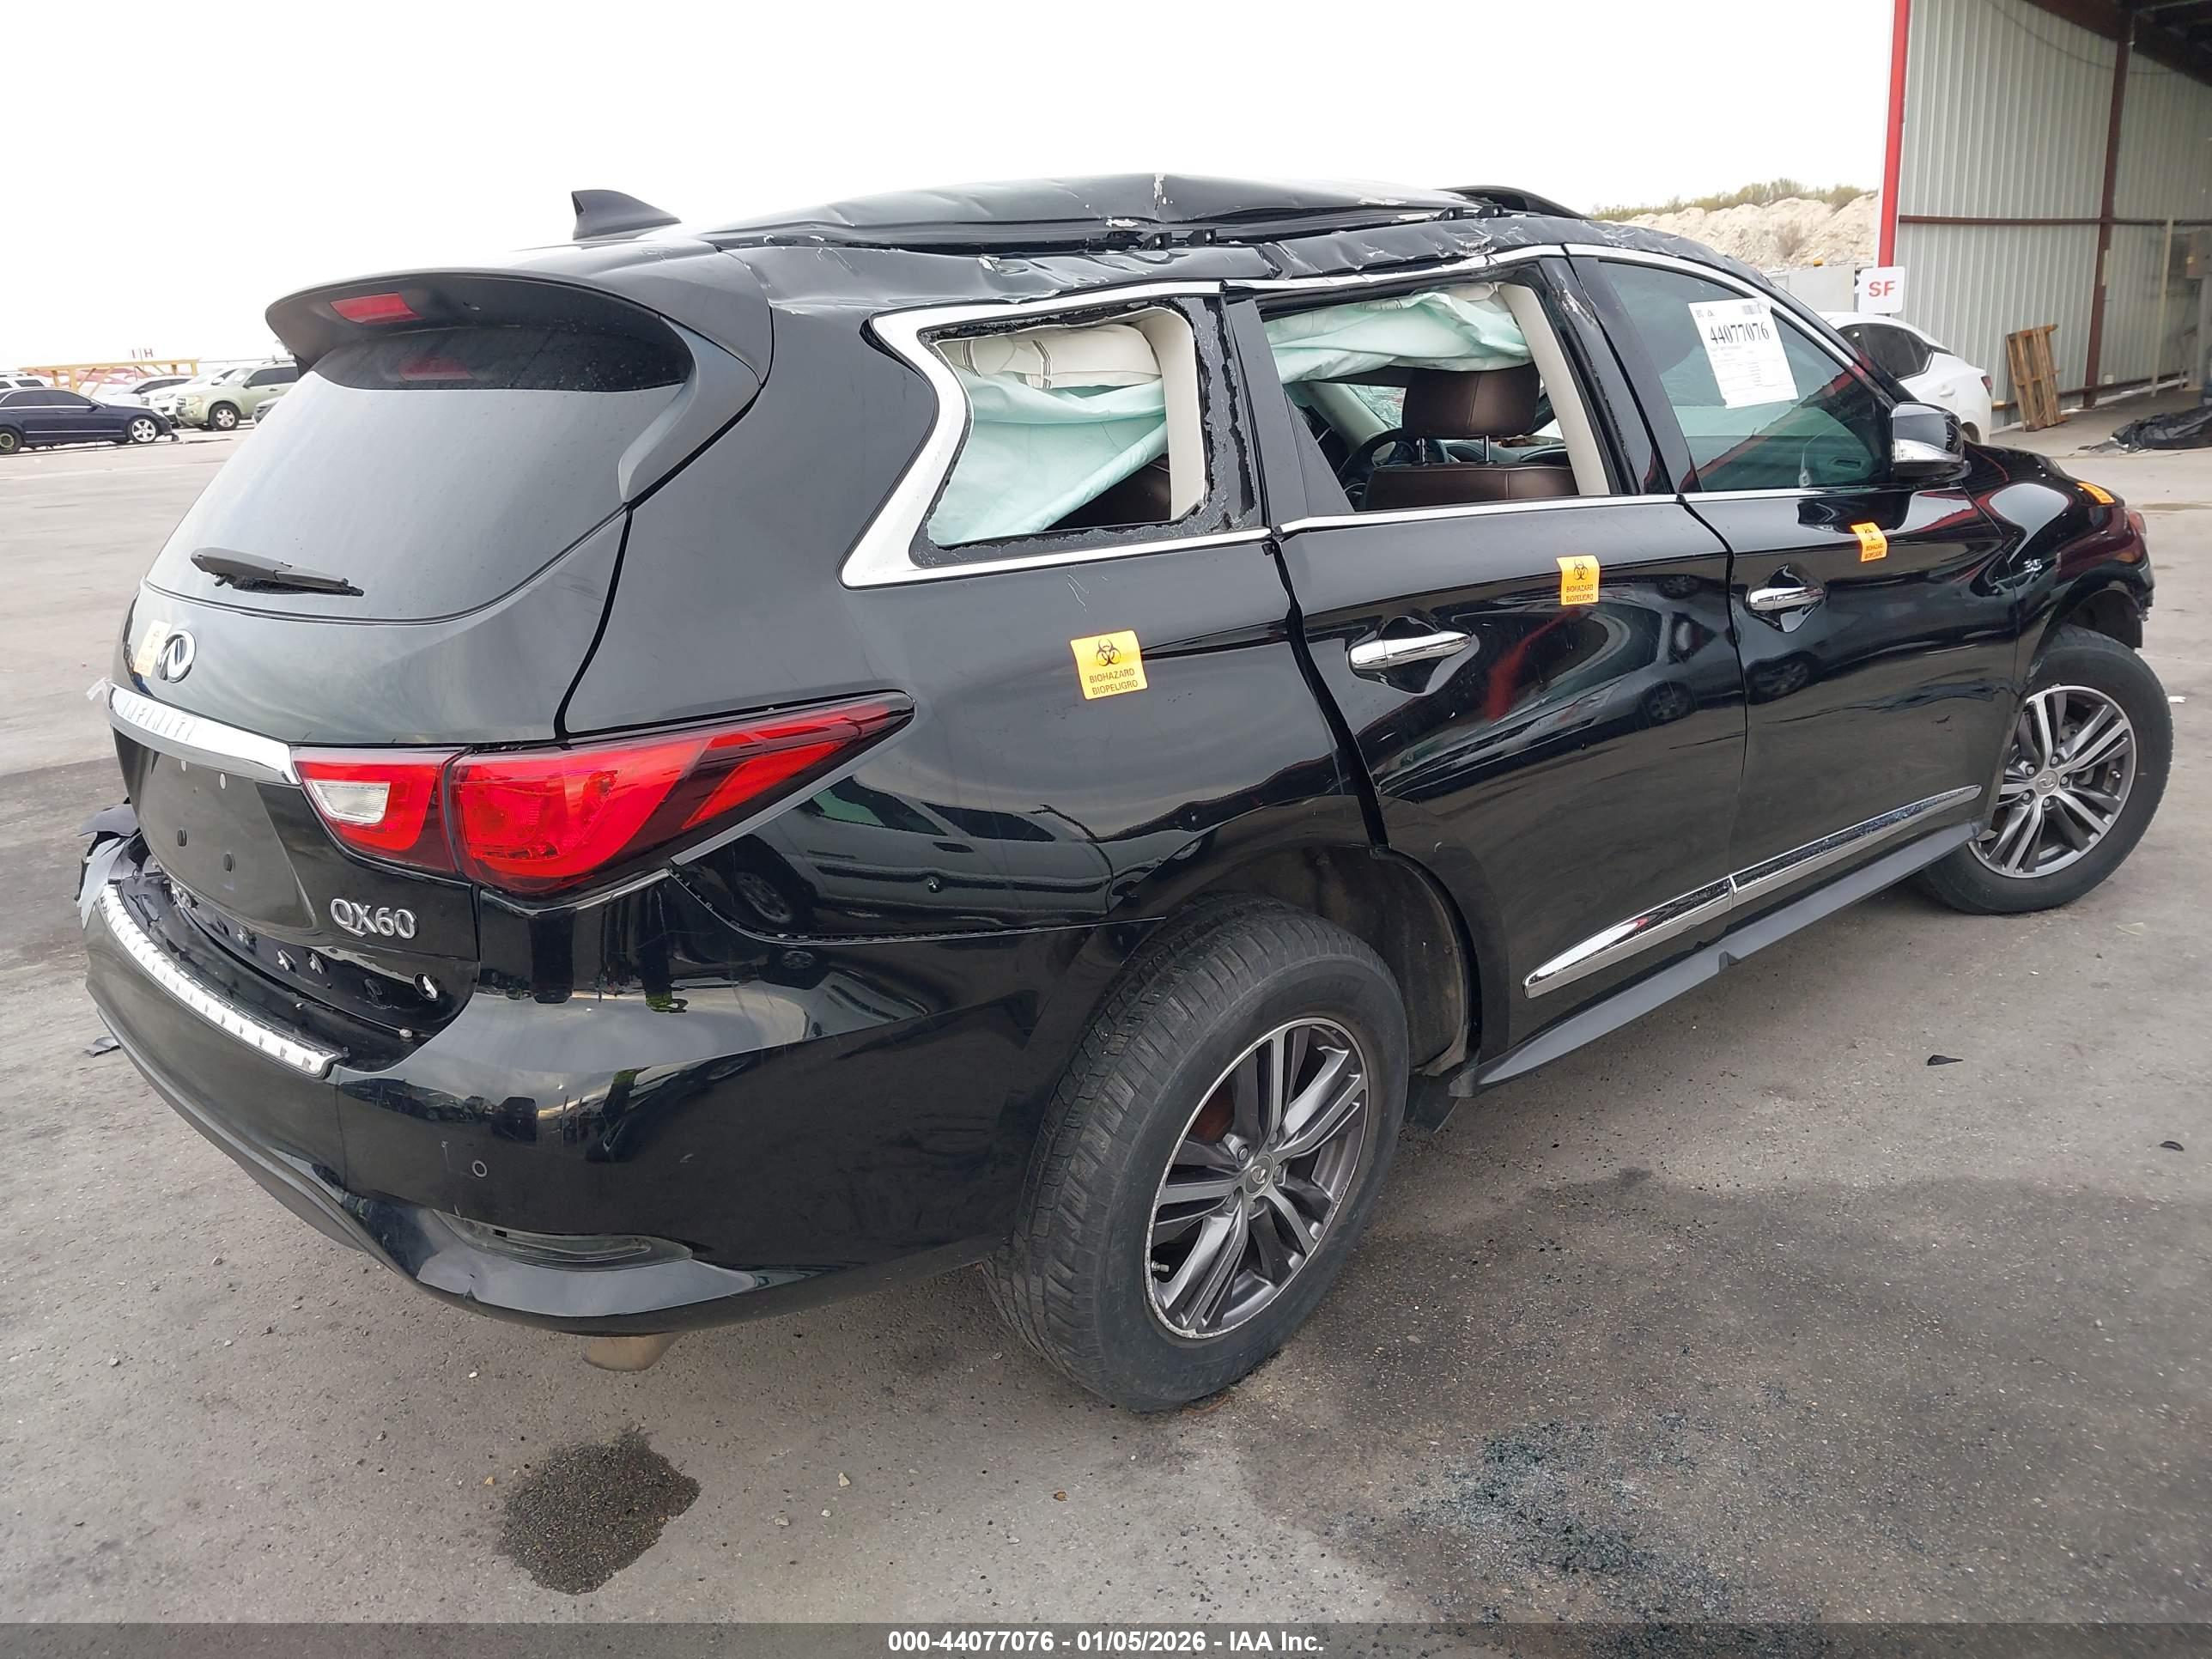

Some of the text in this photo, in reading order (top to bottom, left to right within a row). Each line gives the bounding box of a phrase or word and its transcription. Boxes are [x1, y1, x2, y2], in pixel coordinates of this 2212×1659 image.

[1869, 280, 1895, 297] SF
[1710, 321, 1770, 344] 44077076
[1089, 668, 1135, 684] BIOHAZARD
[1091, 679, 1139, 696] BIOPELIGRO
[330, 898, 416, 939] QX60
